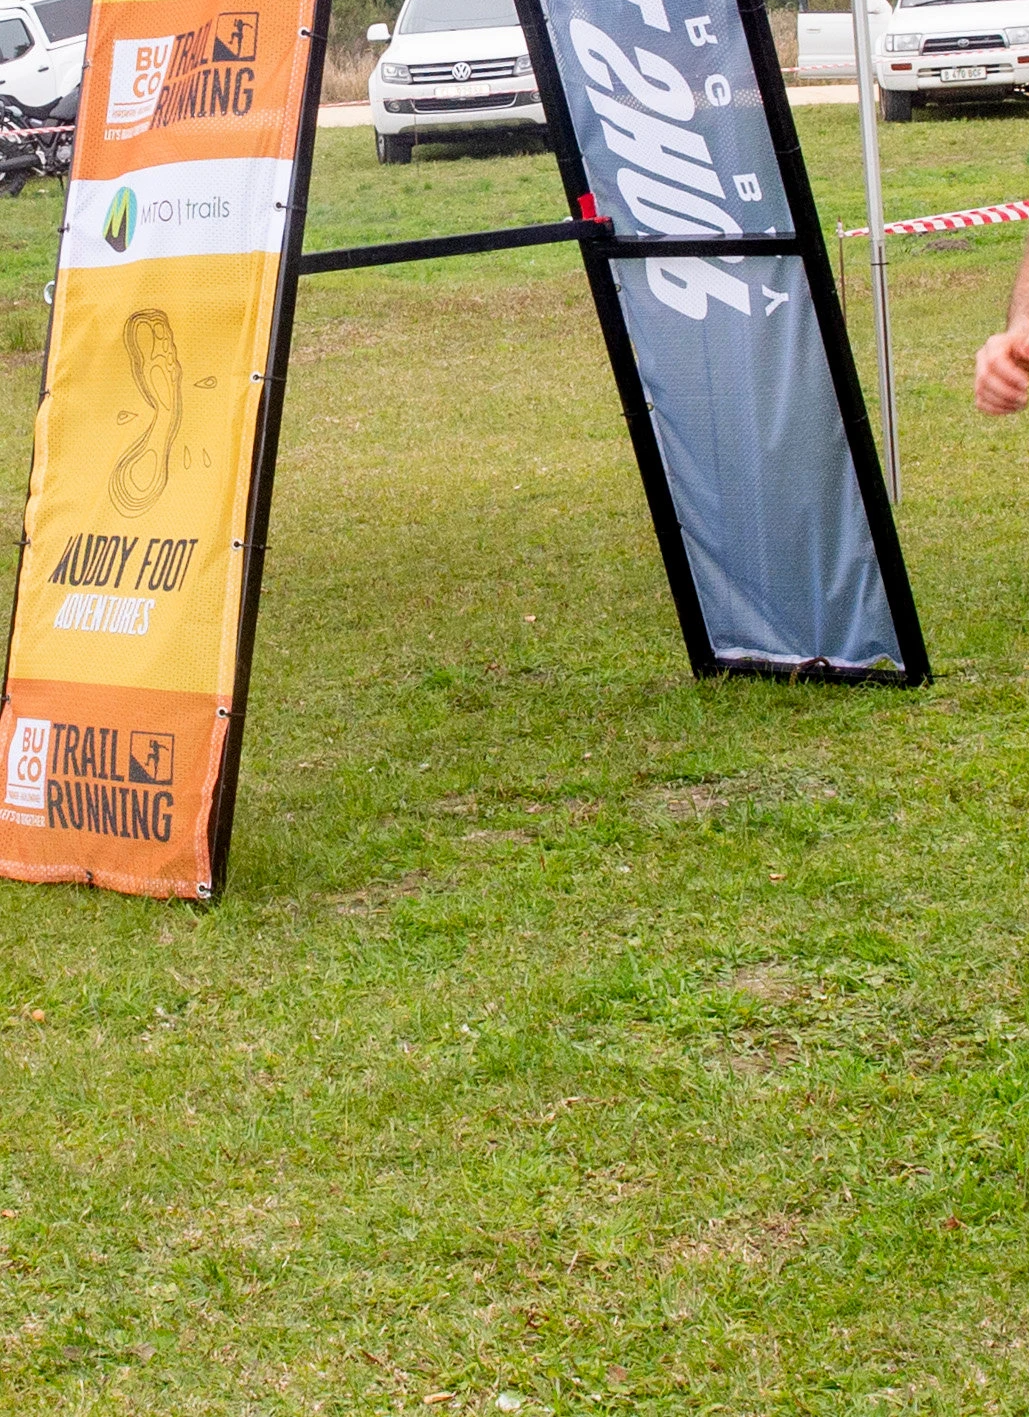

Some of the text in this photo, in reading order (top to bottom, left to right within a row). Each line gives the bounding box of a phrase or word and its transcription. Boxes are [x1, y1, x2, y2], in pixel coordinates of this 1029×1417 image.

[136, 44, 168, 72] BU
[168, 18, 213, 80] TRAIL
[132, 70, 161, 98] CO
[150, 66, 255, 130] RUNNING
[141, 196, 230, 225] MTO trails
[134, 538, 199, 592] FOOT
[53, 592, 156, 636] ADVENTURES
[22, 727, 45, 753] BU
[53, 723, 124, 782] TRAIL
[17, 755, 42, 783] CO
[47, 778, 174, 843] RUNNING
